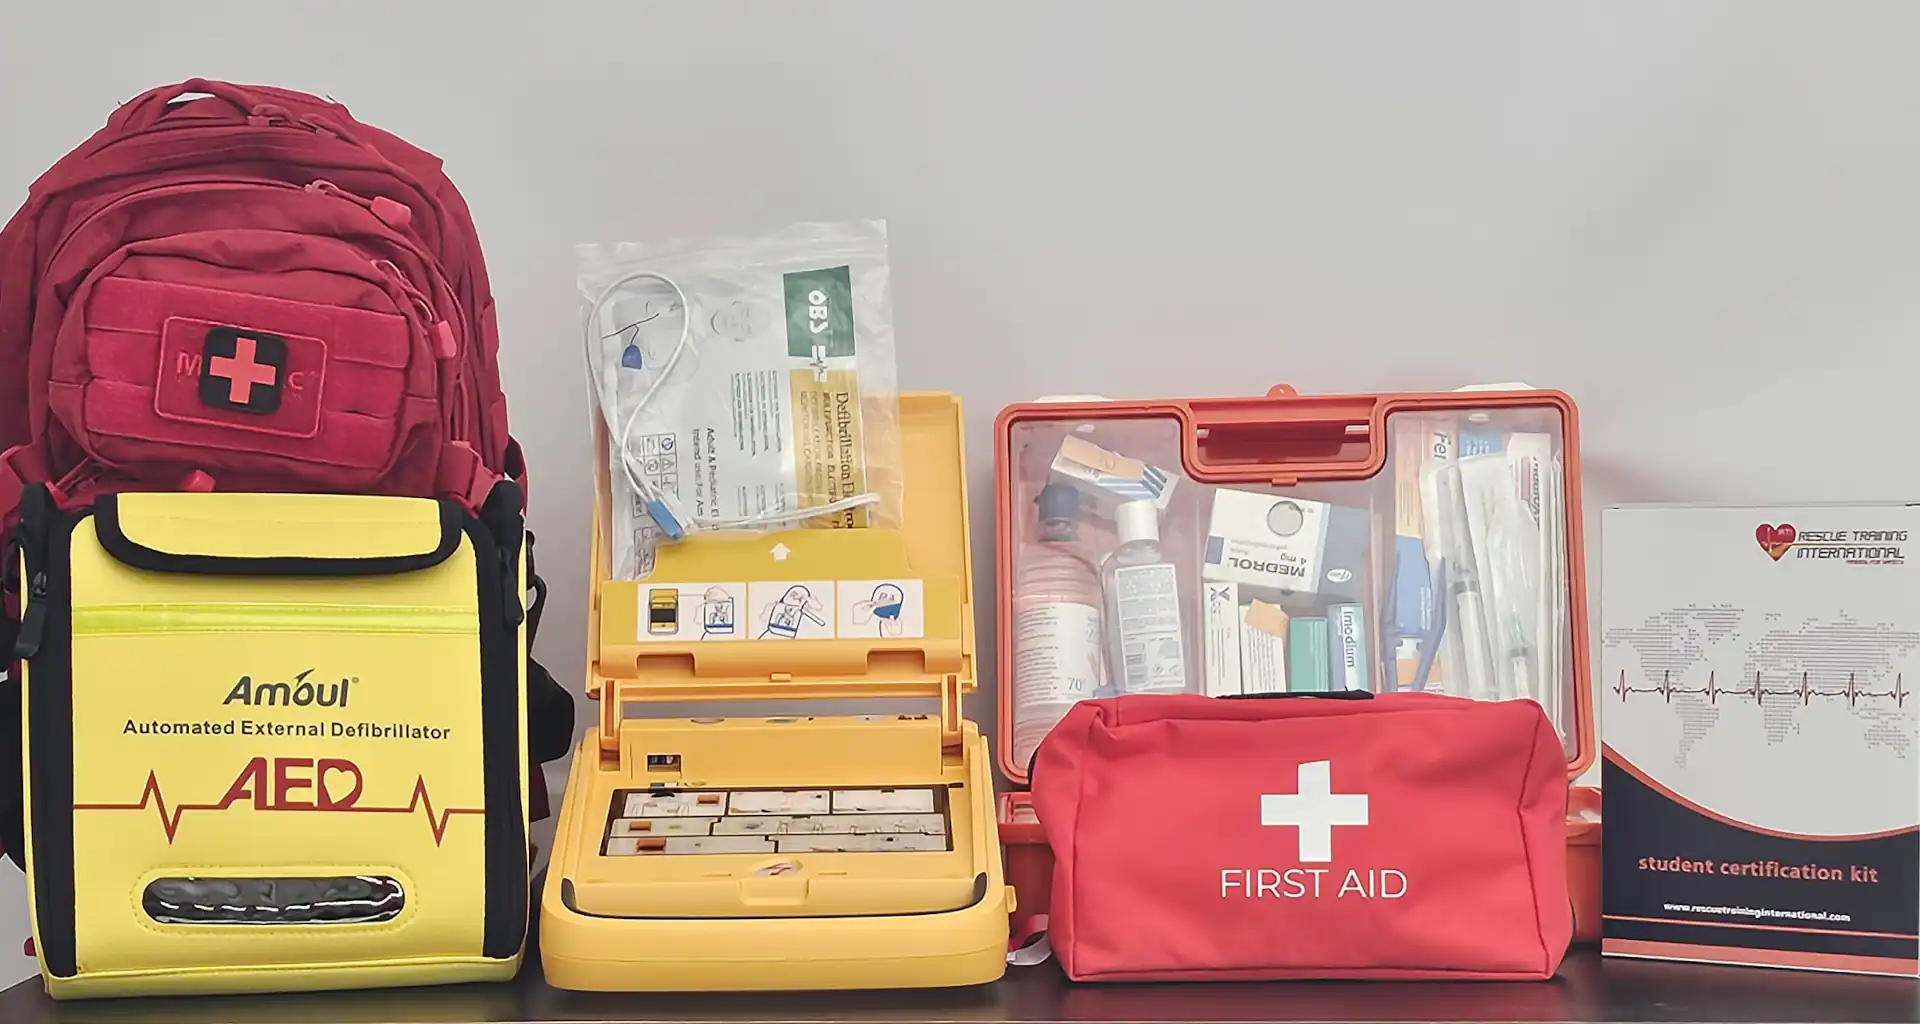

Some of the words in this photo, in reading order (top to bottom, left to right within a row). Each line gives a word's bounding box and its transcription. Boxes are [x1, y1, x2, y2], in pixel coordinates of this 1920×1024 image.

[836, 391, 854, 480] Defibrillation
[1798, 531, 1847, 542] RESCUE
[1853, 530, 1908, 542] TRAINING
[1797, 547, 1905, 559] INTERNATIONAL
[1229, 557, 1306, 578] MEDROL
[123, 719, 235, 736] Automated
[241, 720, 325, 737] External
[331, 721, 451, 740] Defibrillator
[218, 757, 364, 810] AED
[1638, 856, 1715, 875] student
[1720, 860, 1844, 882] certification
[1850, 865, 1879, 883] kit
[1220, 868, 1329, 898] FIRST
[1337, 868, 1408, 898] AID
